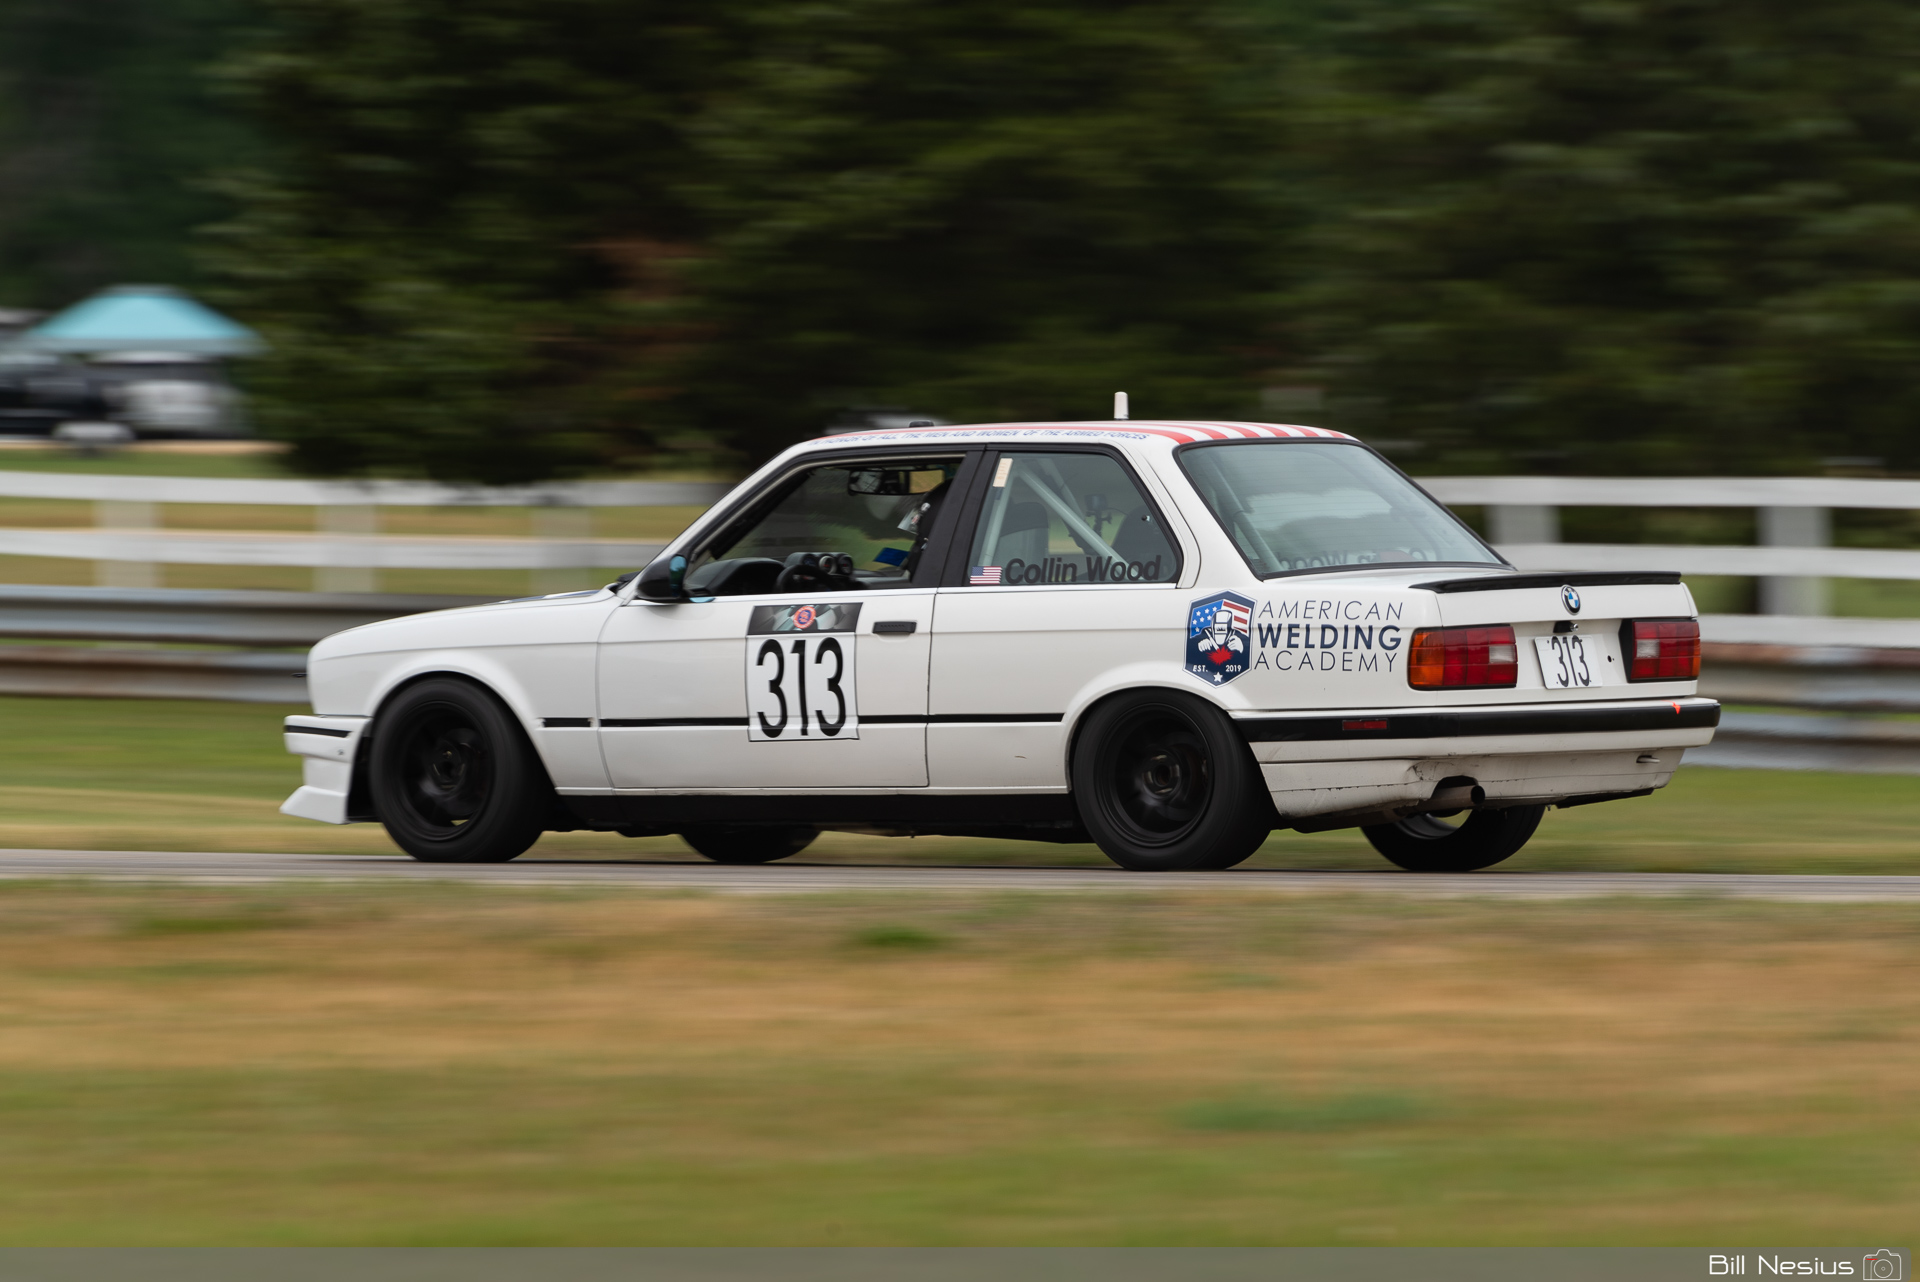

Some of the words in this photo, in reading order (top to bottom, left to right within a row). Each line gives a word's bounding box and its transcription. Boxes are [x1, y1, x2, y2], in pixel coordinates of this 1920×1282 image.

[1103, 431, 1149, 440] FORCES
[1005, 557, 1077, 584] Collin
[1086, 555, 1161, 582] Wood
[1258, 600, 1403, 620] AMERICAN
[1258, 623, 1402, 650] WELDING
[1192, 664, 1208, 672] EST.
[1225, 664, 1242, 672] 2019
[1254, 650, 1398, 672] ACADEMY
[1551, 635, 1591, 687] 313
[756, 637, 846, 738] 313
